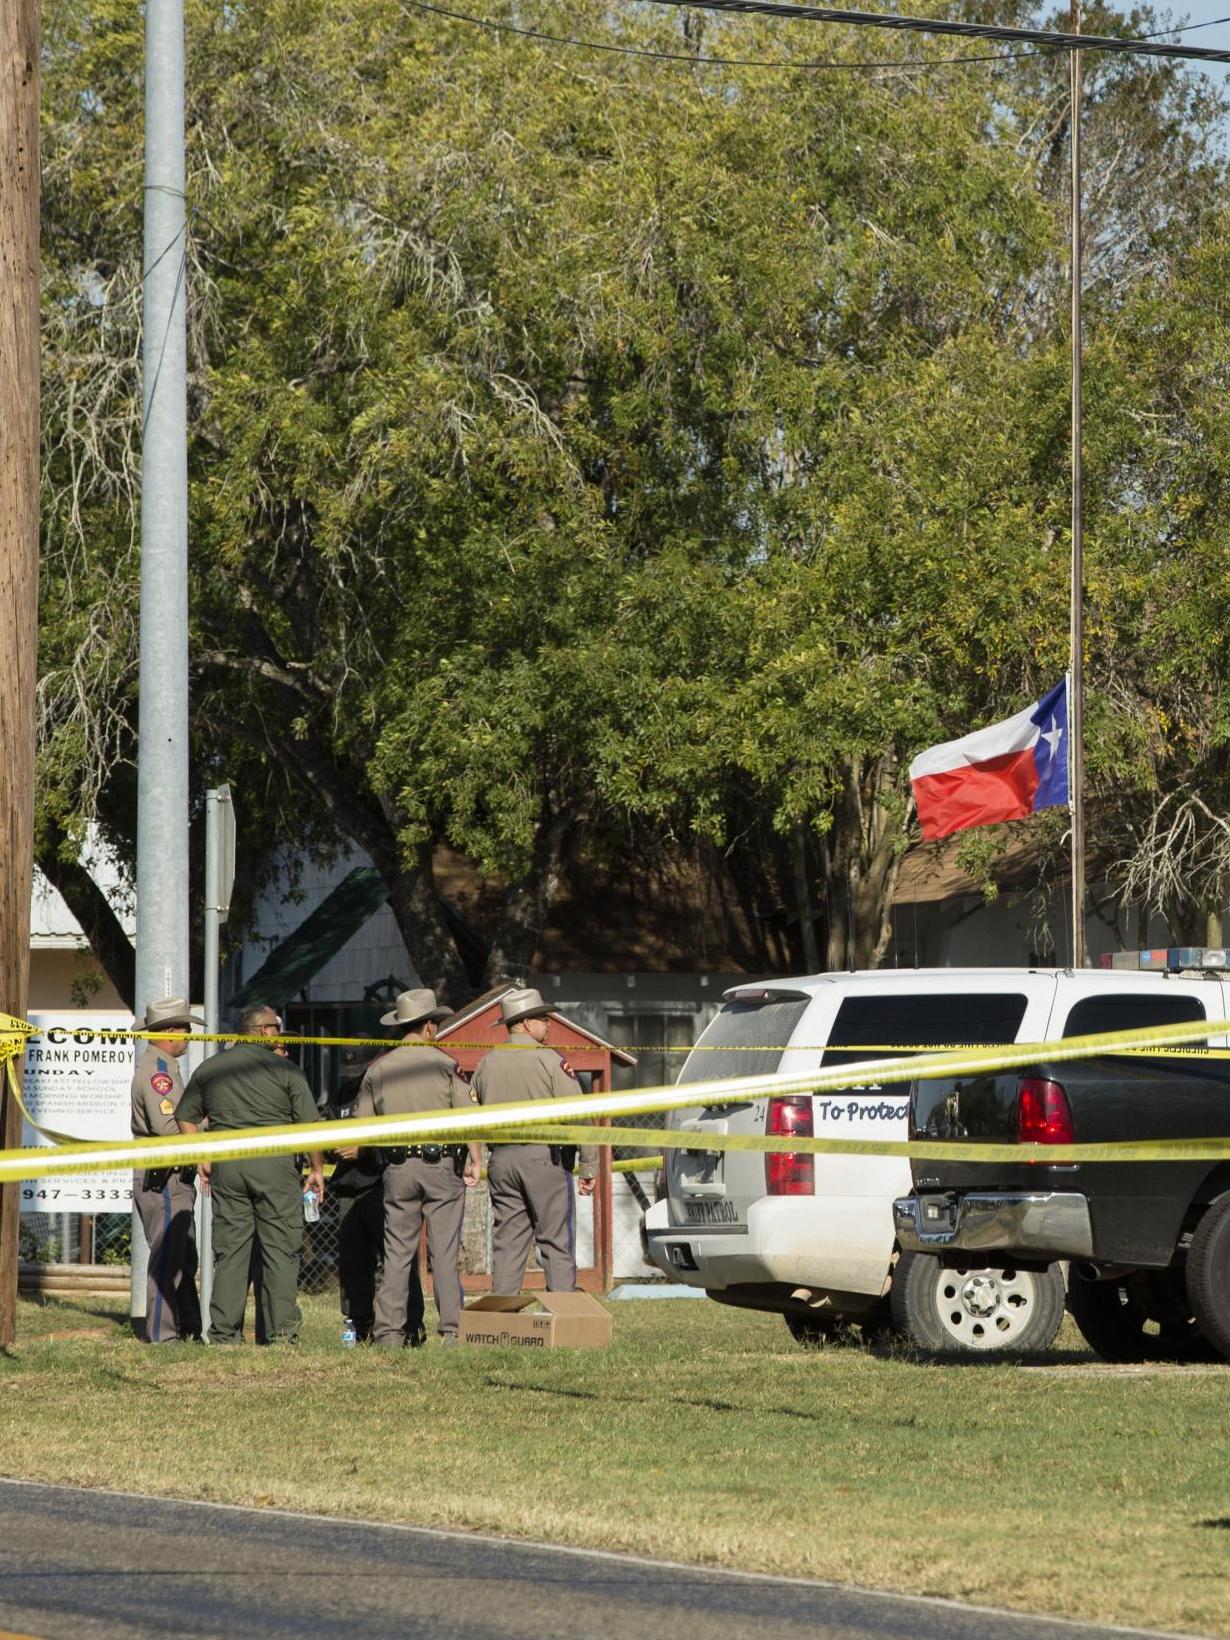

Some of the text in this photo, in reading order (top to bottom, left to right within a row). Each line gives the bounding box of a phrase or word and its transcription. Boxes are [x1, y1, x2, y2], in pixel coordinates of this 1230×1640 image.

[28, 1049, 133, 1063] FRANK POMEROY
[819, 1101, 845, 1121] To
[465, 1333, 544, 1348] WATCH GUARD
